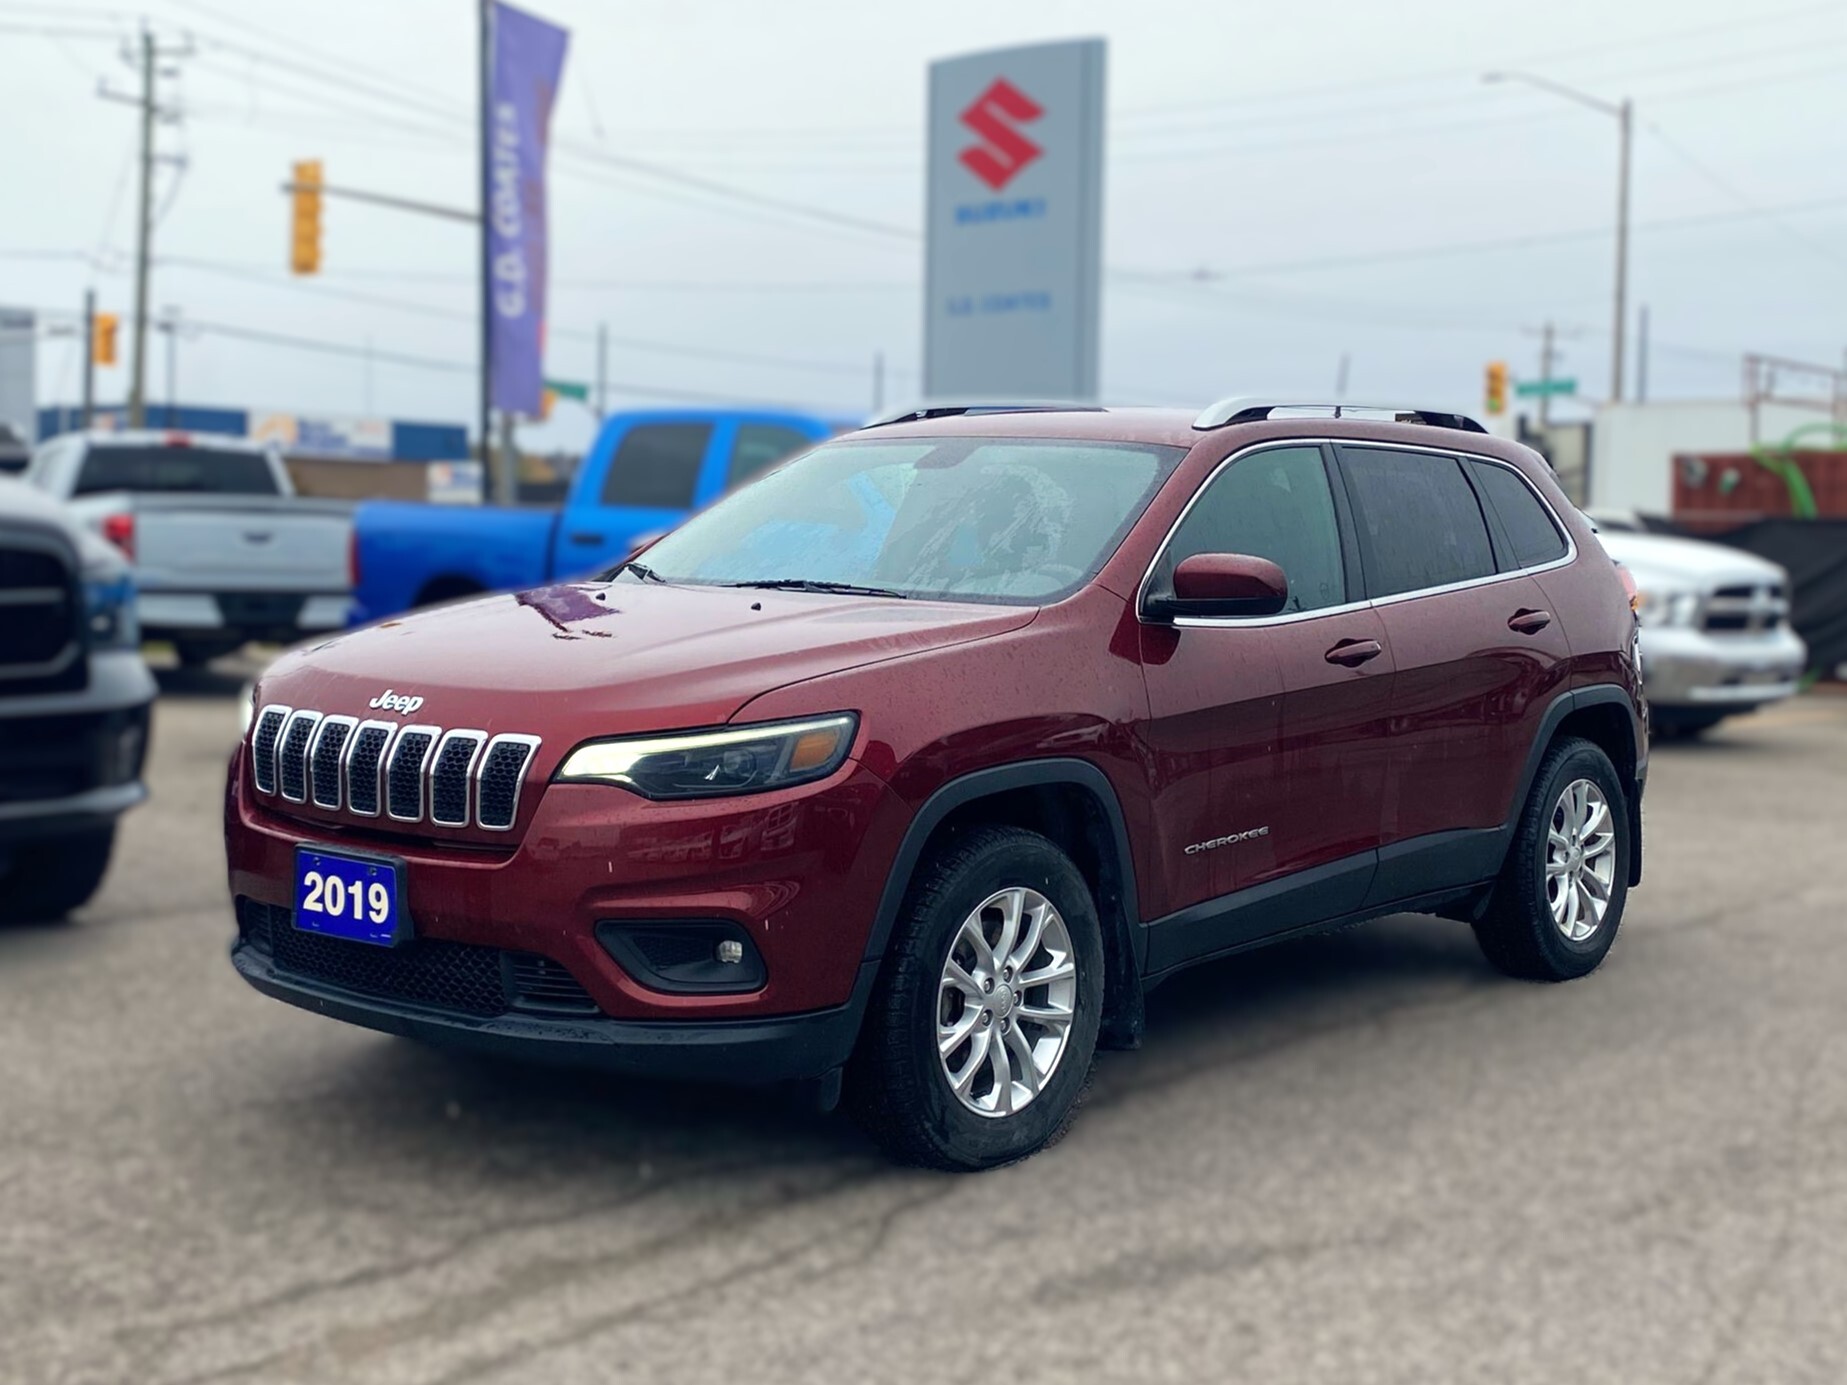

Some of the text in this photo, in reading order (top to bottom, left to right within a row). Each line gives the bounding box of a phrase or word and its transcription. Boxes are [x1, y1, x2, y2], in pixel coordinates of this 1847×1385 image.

[369, 689, 424, 716] Jeep
[1184, 826, 1269, 854] CHEROKEE
[303, 871, 389, 924] 2019
